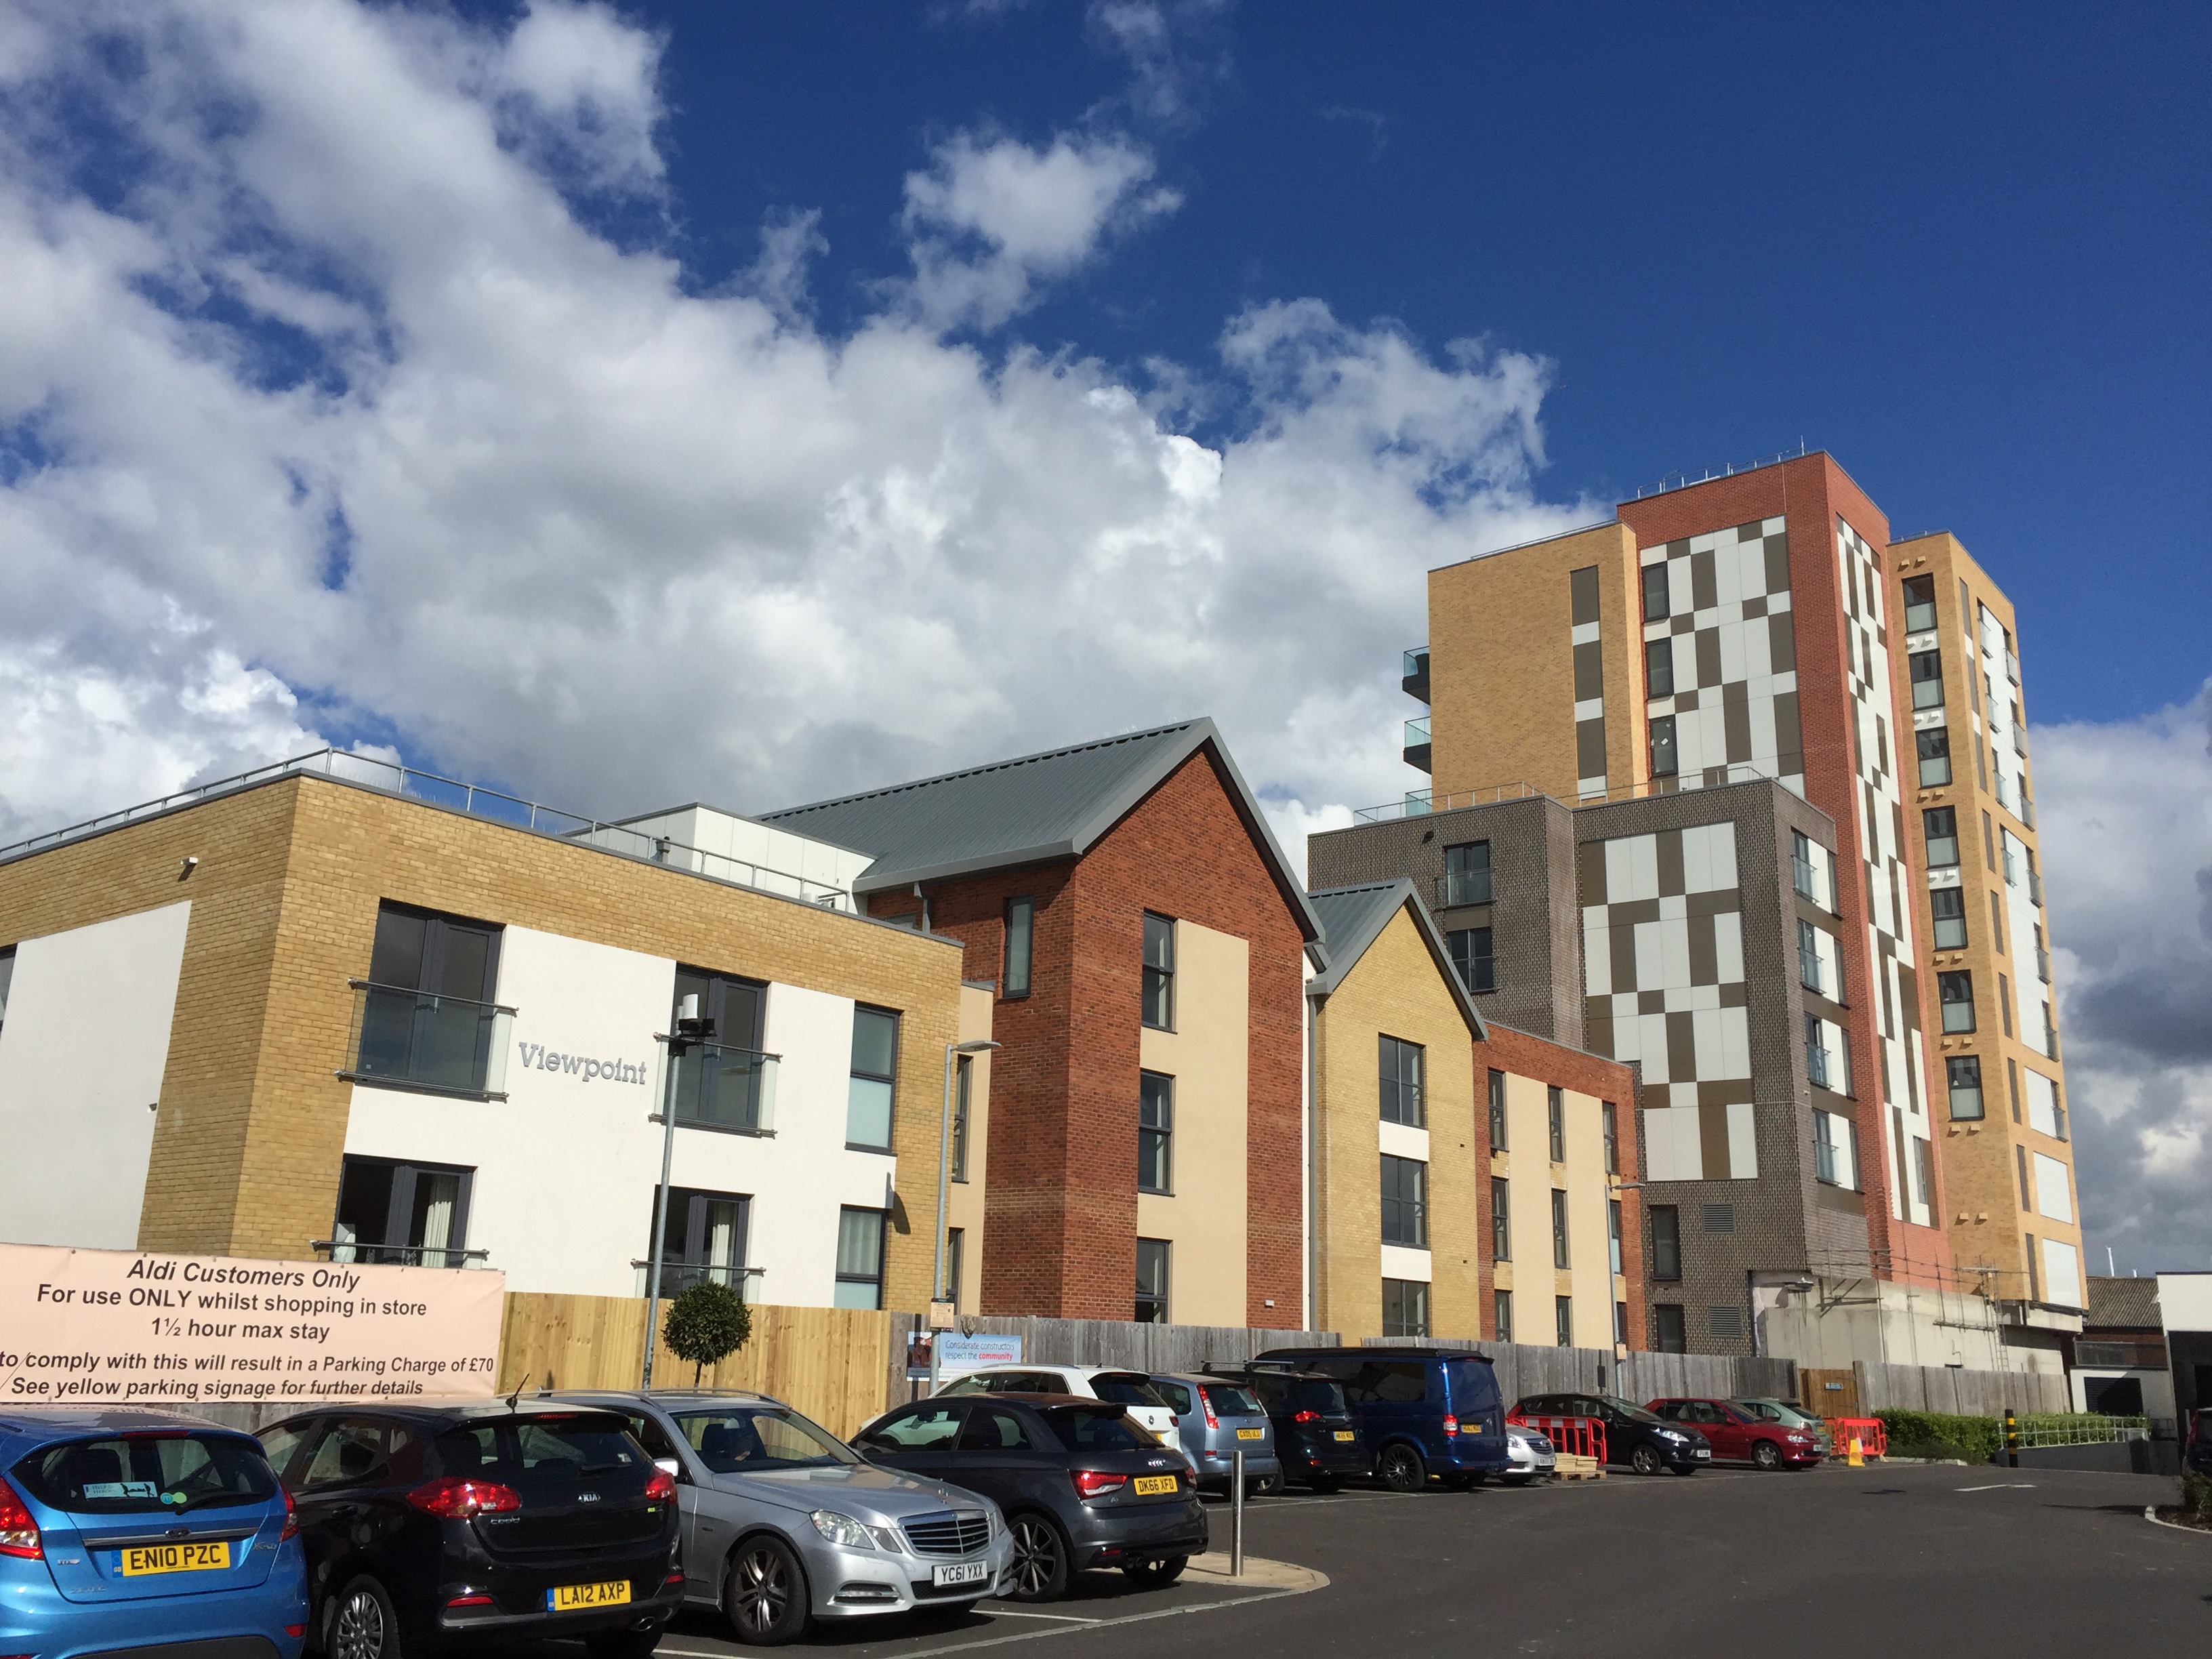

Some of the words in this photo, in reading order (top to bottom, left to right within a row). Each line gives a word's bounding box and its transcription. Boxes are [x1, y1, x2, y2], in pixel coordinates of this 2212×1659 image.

[519, 1042, 646, 1084] Viewpoint
[127, 1260, 176, 1279] Aldi
[184, 1263, 304, 1286] Customers
[313, 1269, 360, 1293] Only
[38, 1284, 75, 1303] For
[83, 1291, 121, 1305] use
[129, 1288, 192, 1307] ONLY
[199, 1292, 258, 1310] whilst
[265, 1295, 353, 1317] shopping
[361, 1298, 375, 1313] in
[383, 1300, 426, 1315] store
[188, 1319, 237, 1336] hour
[243, 1326, 283, 1338] max
[290, 1324, 329, 1343] stay
[945, 1340, 979, 1350] Considerate
[981, 1343, 1015, 1351] constructors
[945, 1353, 966, 1361] respect
[968, 1351, 977, 1359] the
[979, 1352, 1013, 1361] community
[0, 1351, 18, 1367] to
[26, 1352, 100, 1372] comply
[107, 1353, 146, 1368] with
[154, 1354, 187, 1370] this
[195, 1355, 225, 1370] will
[231, 1356, 281, 1370] result
[287, 1356, 302, 1370] in
[308, 1360, 317, 1371] a
[323, 1357, 385, 1375] Parking
[392, 1357, 445, 1375] Charge
[451, 1358, 466, 1372] of
[469, 1358, 493, 1372] £70
[12, 1377, 49, 1394] See
[55, 1378, 121, 1398] yellow
[126, 1379, 198, 1399] parking
[204, 1380, 275, 1399] signage
[281, 1380, 306, 1394] for
[310, 1380, 367, 1394] further
[371, 1380, 422, 1394] details
[1139, 1479, 1159, 1492] DK66
[1160, 1478, 1174, 1490] XFD
[583, 1494, 598, 1502] KIA
[130, 1548, 177, 1570] EN10
[184, 1545, 221, 1565] PZC
[941, 1565, 964, 1582] YC61
[967, 1563, 983, 1579] YXX
[561, 1585, 594, 1605] LA12
[599, 1583, 625, 1601] AXP
